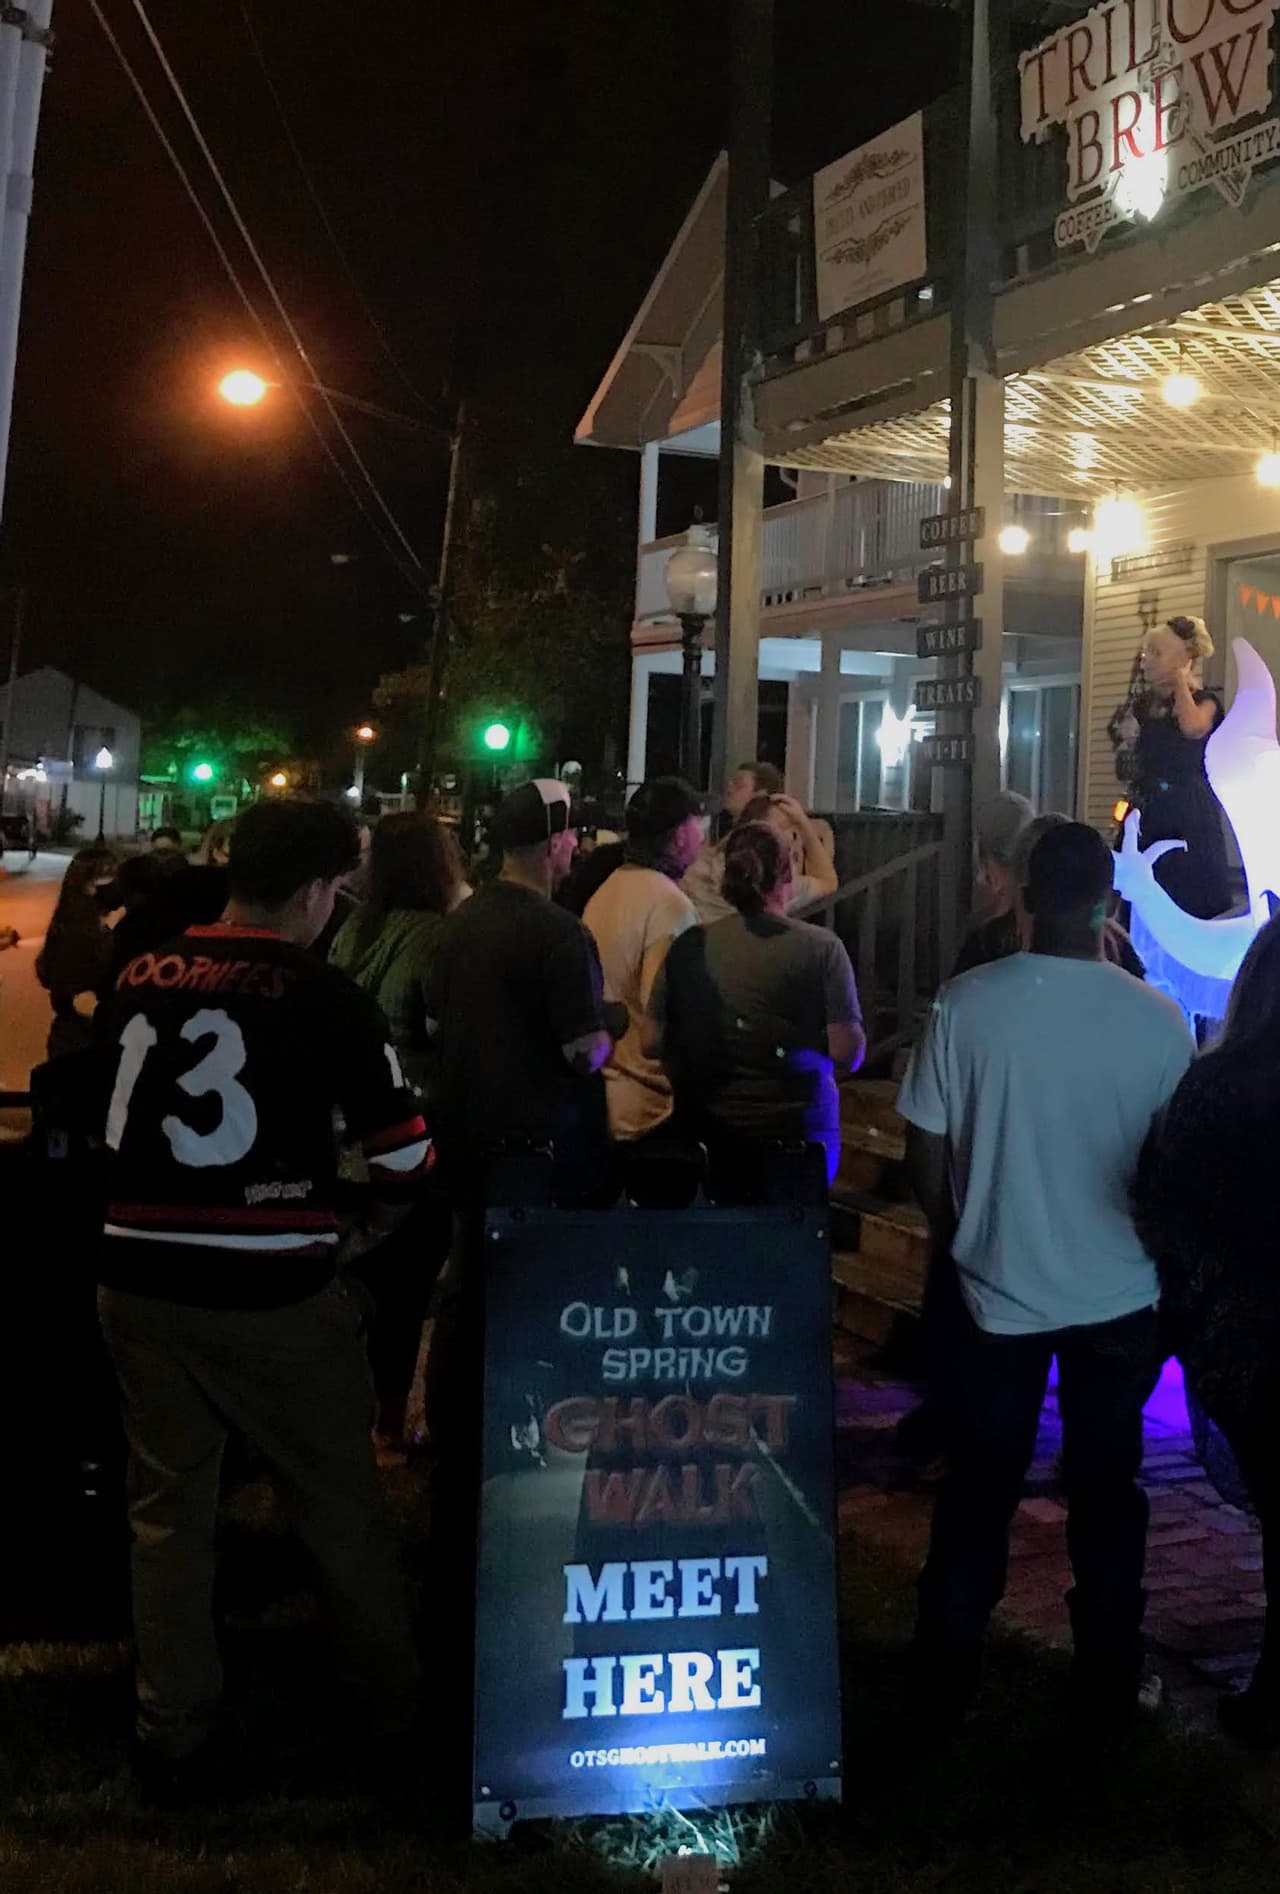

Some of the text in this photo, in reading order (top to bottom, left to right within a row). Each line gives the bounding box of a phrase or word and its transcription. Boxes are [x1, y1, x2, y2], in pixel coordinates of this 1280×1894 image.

[1073, 22, 1264, 190] BREW
[921, 511, 978, 542] COFFEE
[929, 571, 967, 595] BEER
[924, 626, 966, 650] WINE
[918, 680, 975, 704] TREATS
[105, 1008, 257, 1167] 13
[560, 1302, 774, 1339] OLD TOWN
[602, 1347, 749, 1380] SPRING
[543, 1393, 797, 1454] GHOST
[586, 1463, 760, 1524] WALK
[562, 1555, 768, 1624] MEET
[562, 1648, 762, 1719] HERE
